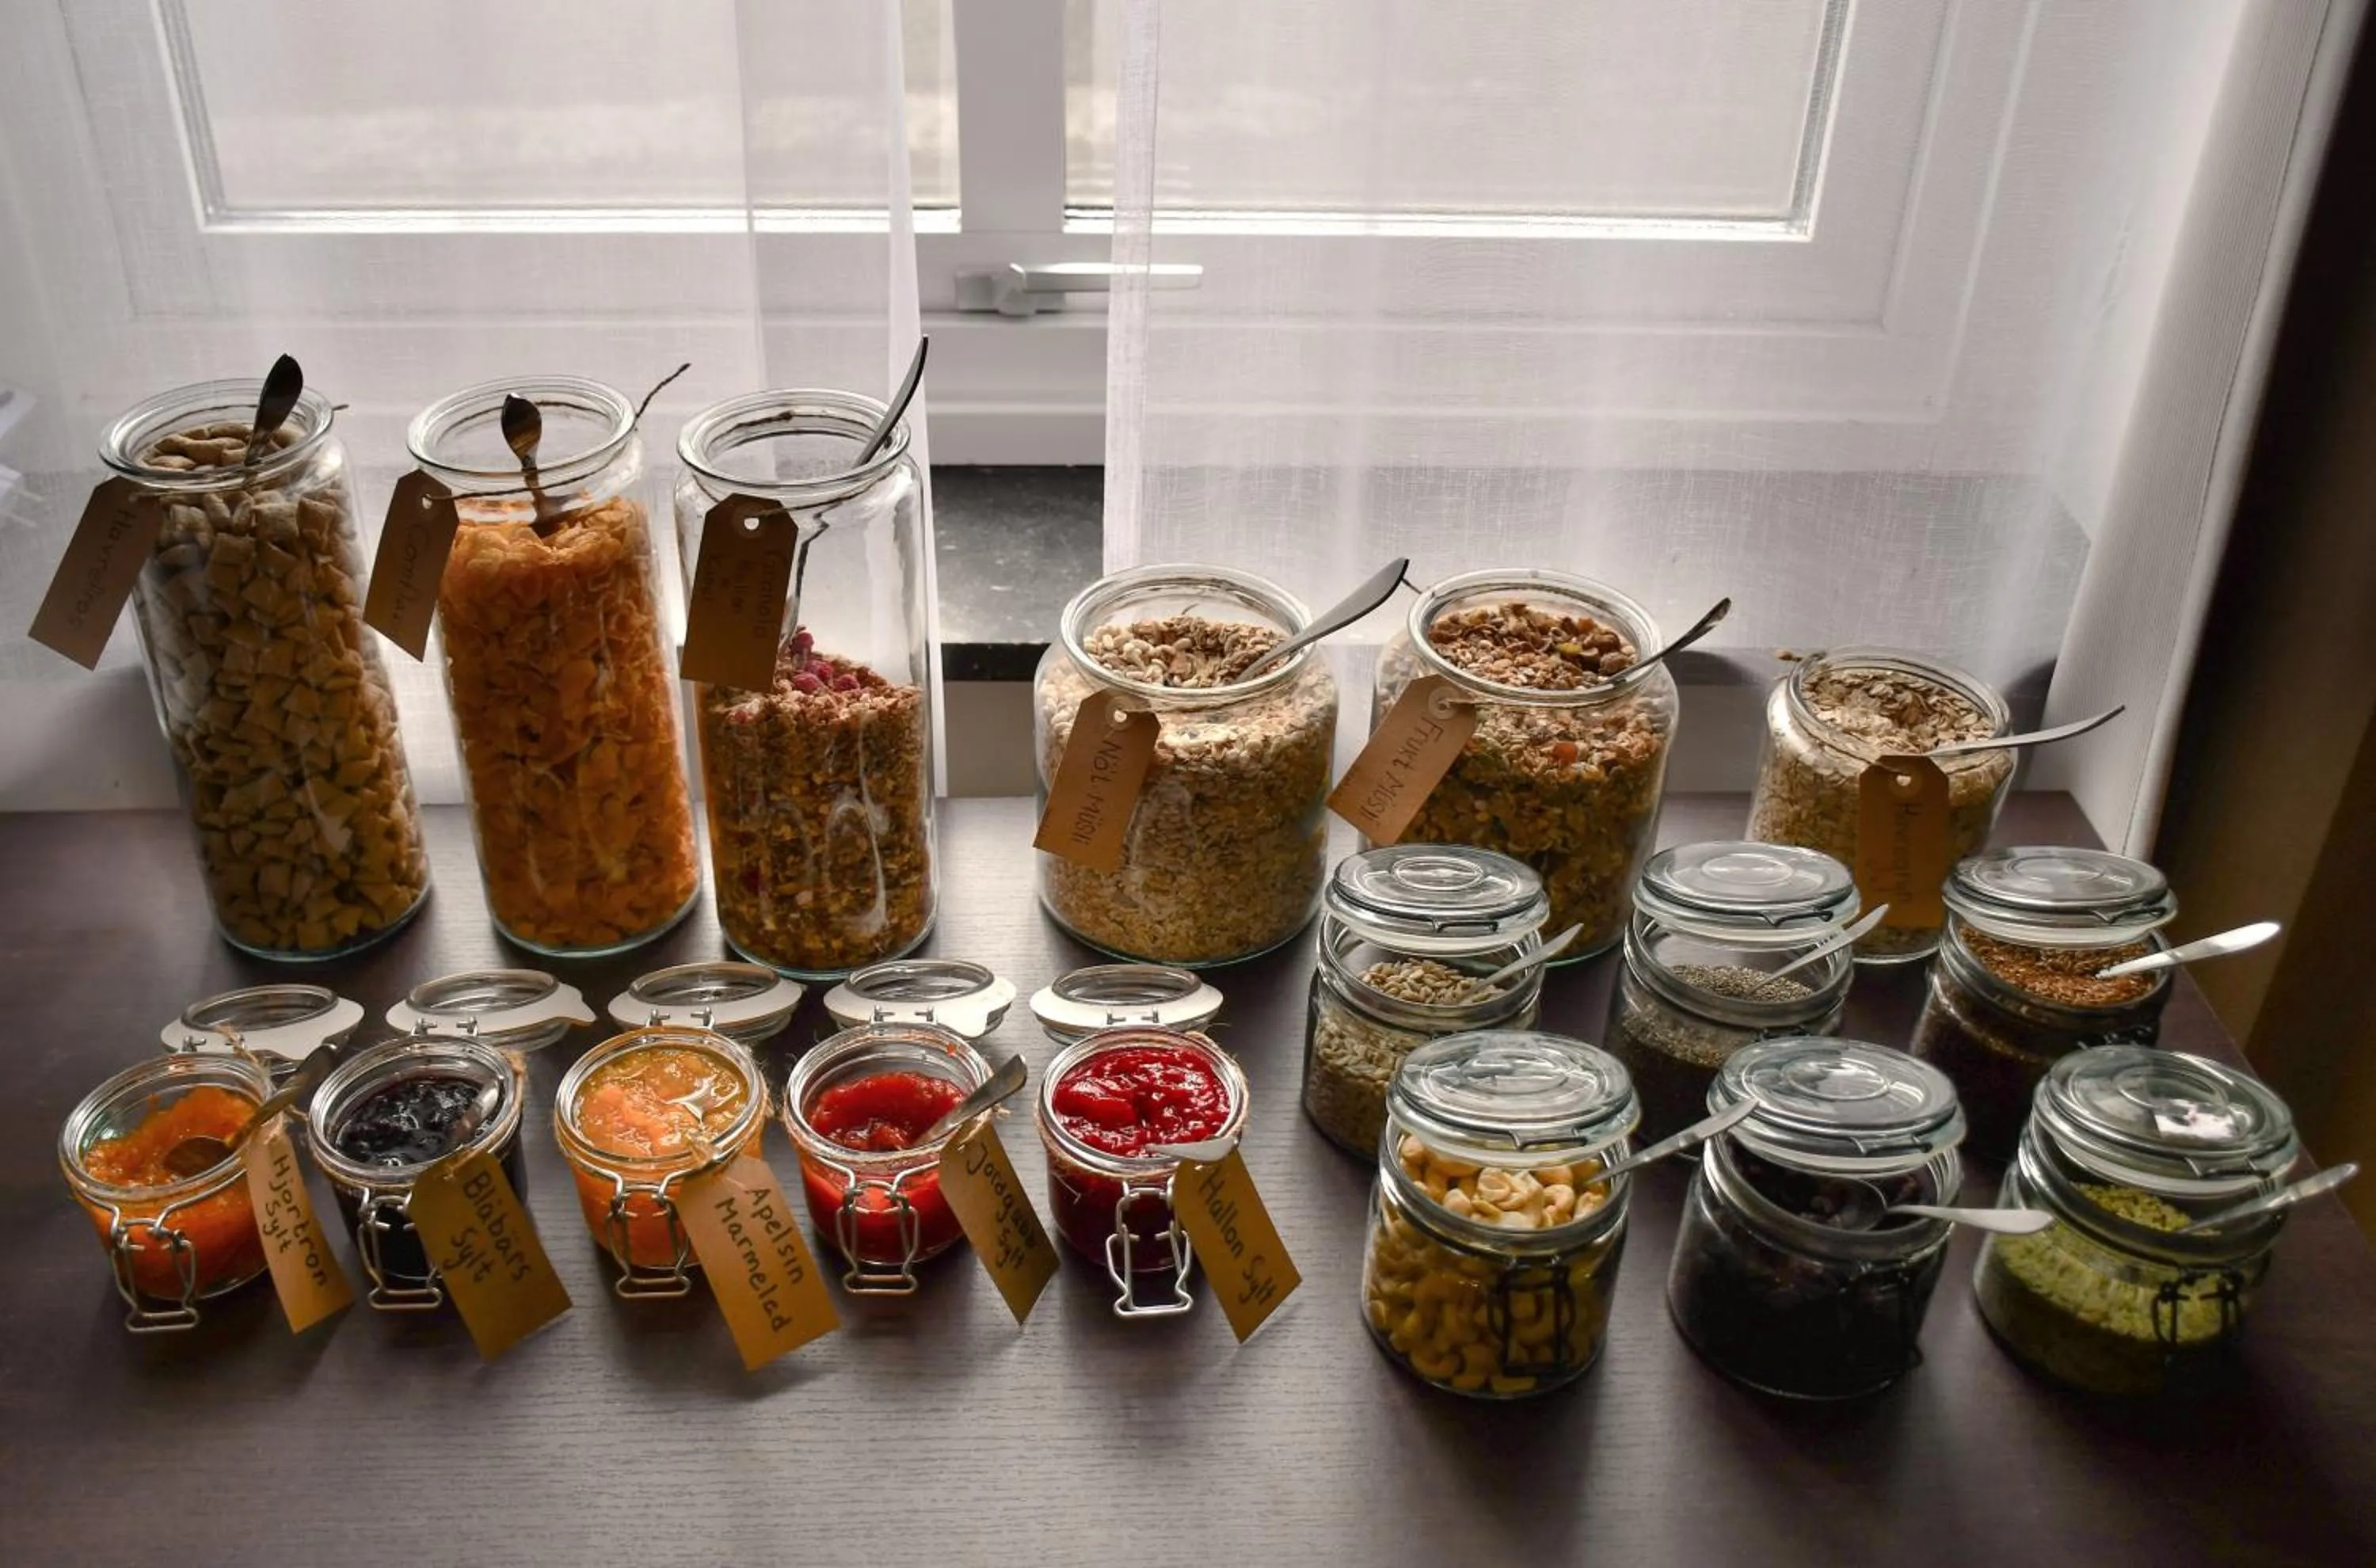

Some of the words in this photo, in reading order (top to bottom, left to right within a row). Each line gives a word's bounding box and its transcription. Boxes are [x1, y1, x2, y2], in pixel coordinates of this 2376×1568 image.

[262, 1201, 292, 1254] Sylt
[269, 1154, 328, 1288] Hjortron
[442, 1227, 496, 1284] Sylt
[463, 1170, 531, 1282] Blåbärs
[714, 1196, 793, 1333] Marmelad
[748, 1187, 805, 1285] Apelsin
[1198, 1165, 1245, 1260] Hallon
[1238, 1254, 1277, 1306] Sylt
